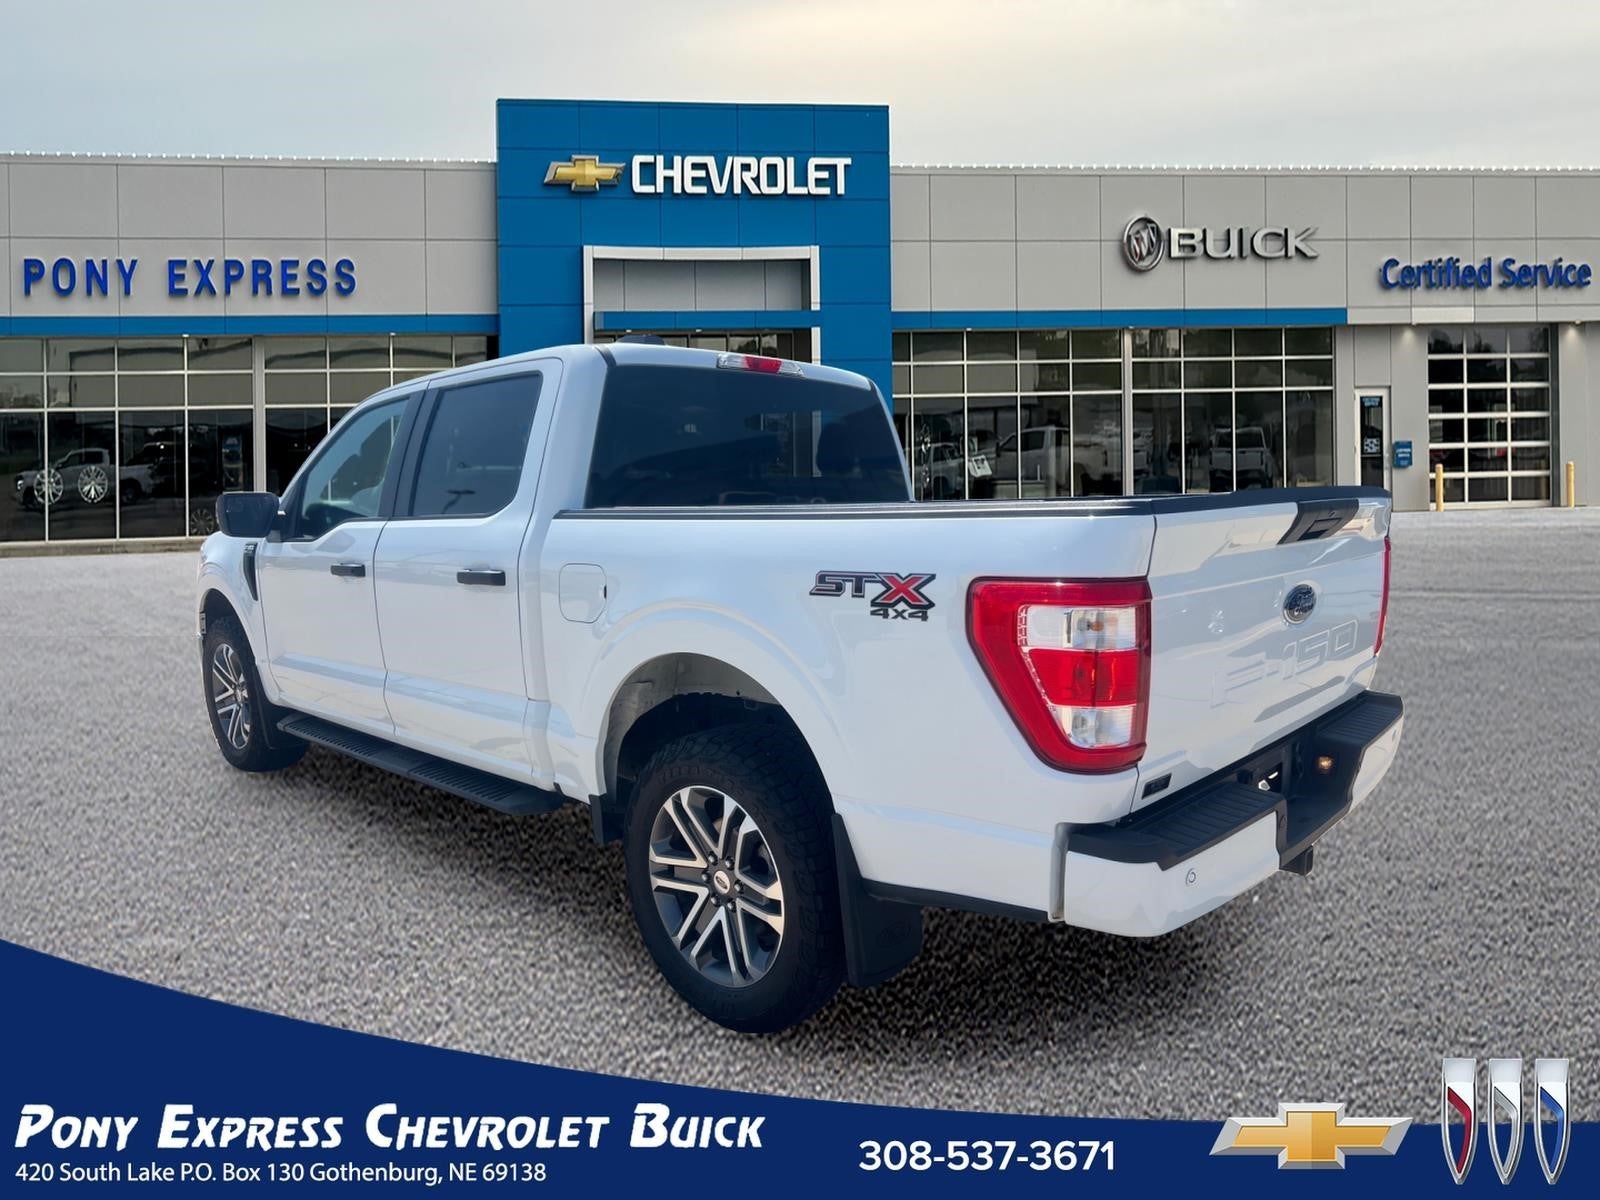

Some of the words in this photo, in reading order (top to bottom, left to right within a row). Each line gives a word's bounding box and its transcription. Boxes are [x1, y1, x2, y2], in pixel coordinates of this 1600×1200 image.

[631, 154, 852, 195] CHEVROLET
[1168, 226, 1320, 260] BUICK
[23, 257, 138, 296] PONY
[167, 257, 356, 297] EXPRESS
[1380, 256, 1492, 289] Certified
[1499, 256, 1592, 288] Service
[809, 570, 937, 610] STX
[1209, 619, 1359, 709] F-150
